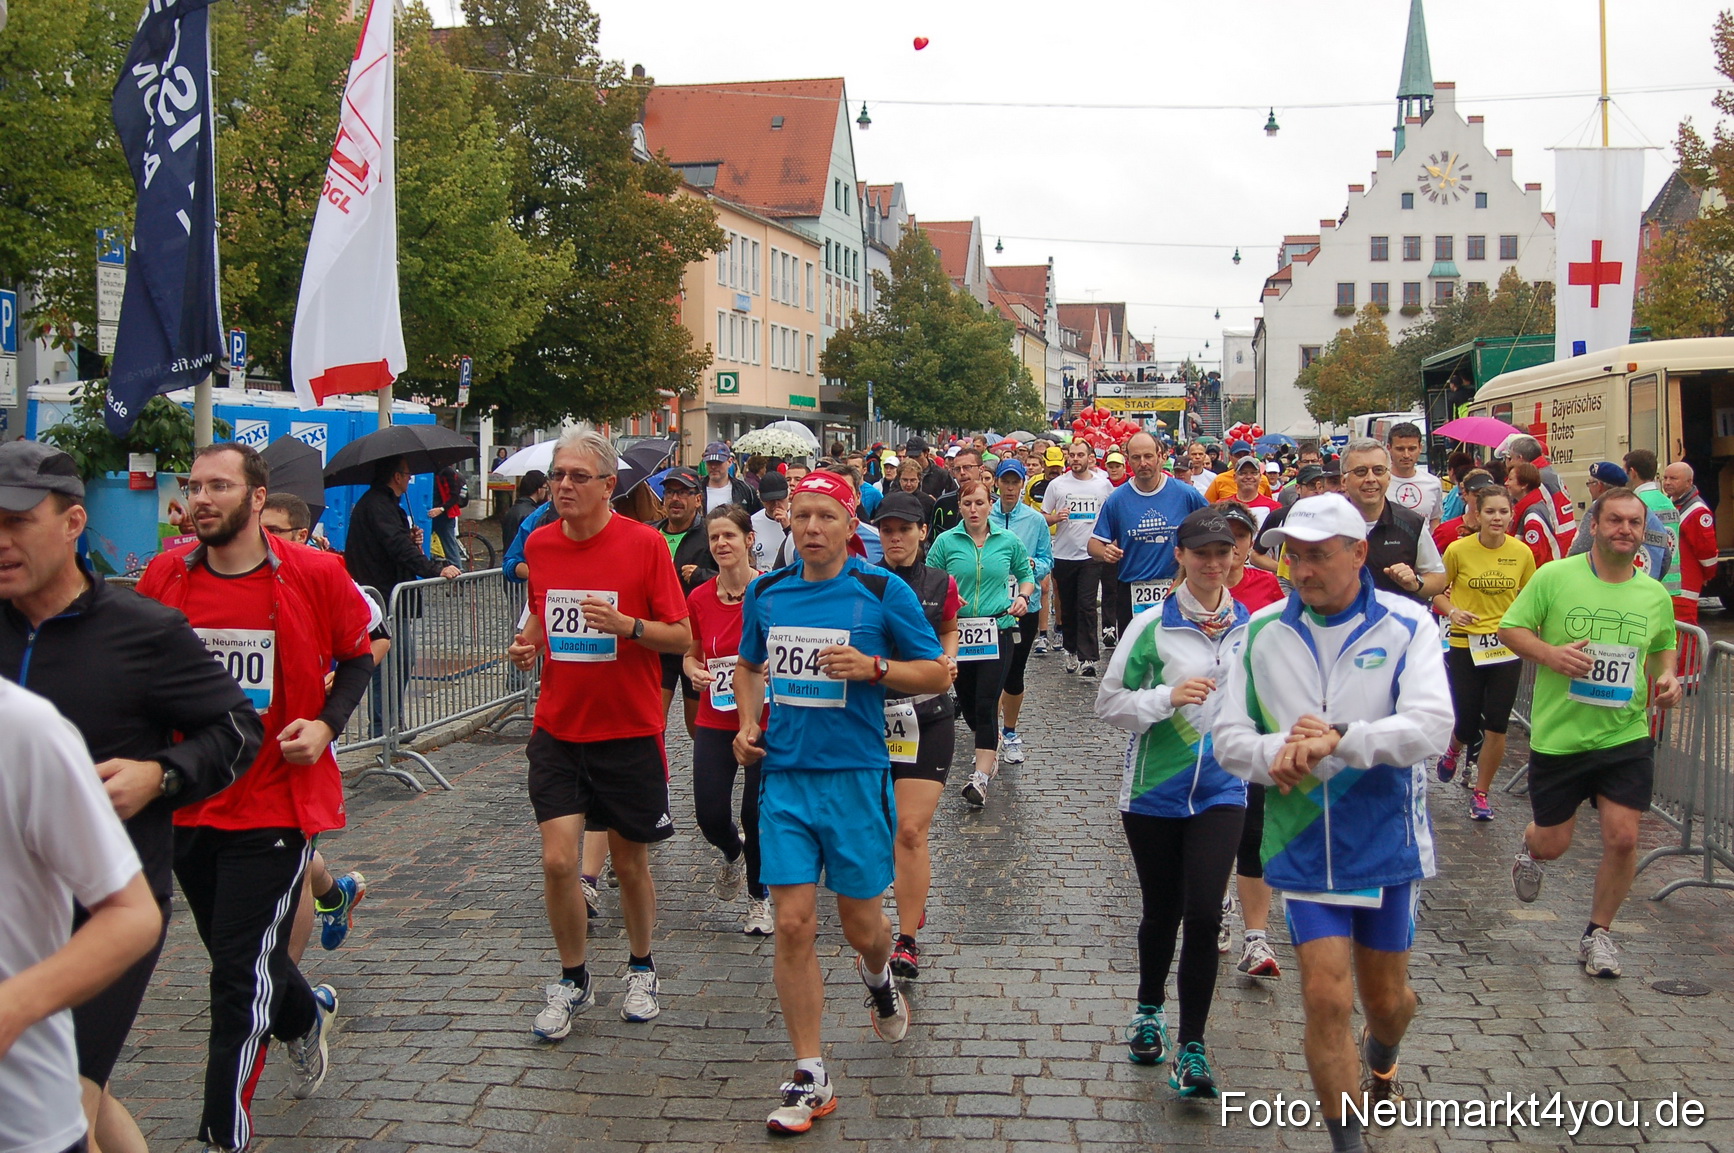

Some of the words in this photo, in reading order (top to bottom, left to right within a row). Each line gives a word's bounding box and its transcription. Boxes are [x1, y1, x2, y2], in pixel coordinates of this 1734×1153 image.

[3, 299, 13, 345] P
[233, 335, 243, 363] P
[462, 364, 470, 382] P
[720, 375, 735, 391] D
[1125, 401, 1156, 409] START
[1552, 393, 1602, 420] Bayerisches
[1551, 422, 1575, 441] Rotes
[1551, 446, 1573, 464] Kreuz
[1071, 501, 1095, 511] 2111
[548, 596, 569, 604] PARTL
[213, 638, 257, 647] Neumarkt
[770, 634, 793, 642] PARTL
[795, 635, 833, 645] Neumarkt
[958, 628, 992, 645] 2621
[559, 640, 598, 652] Joachim
[1598, 650, 1628, 658] Neumarkt
[709, 662, 729, 670] PARTL
[788, 682, 820, 696] Martin
[1590, 687, 1615, 698] Josef
